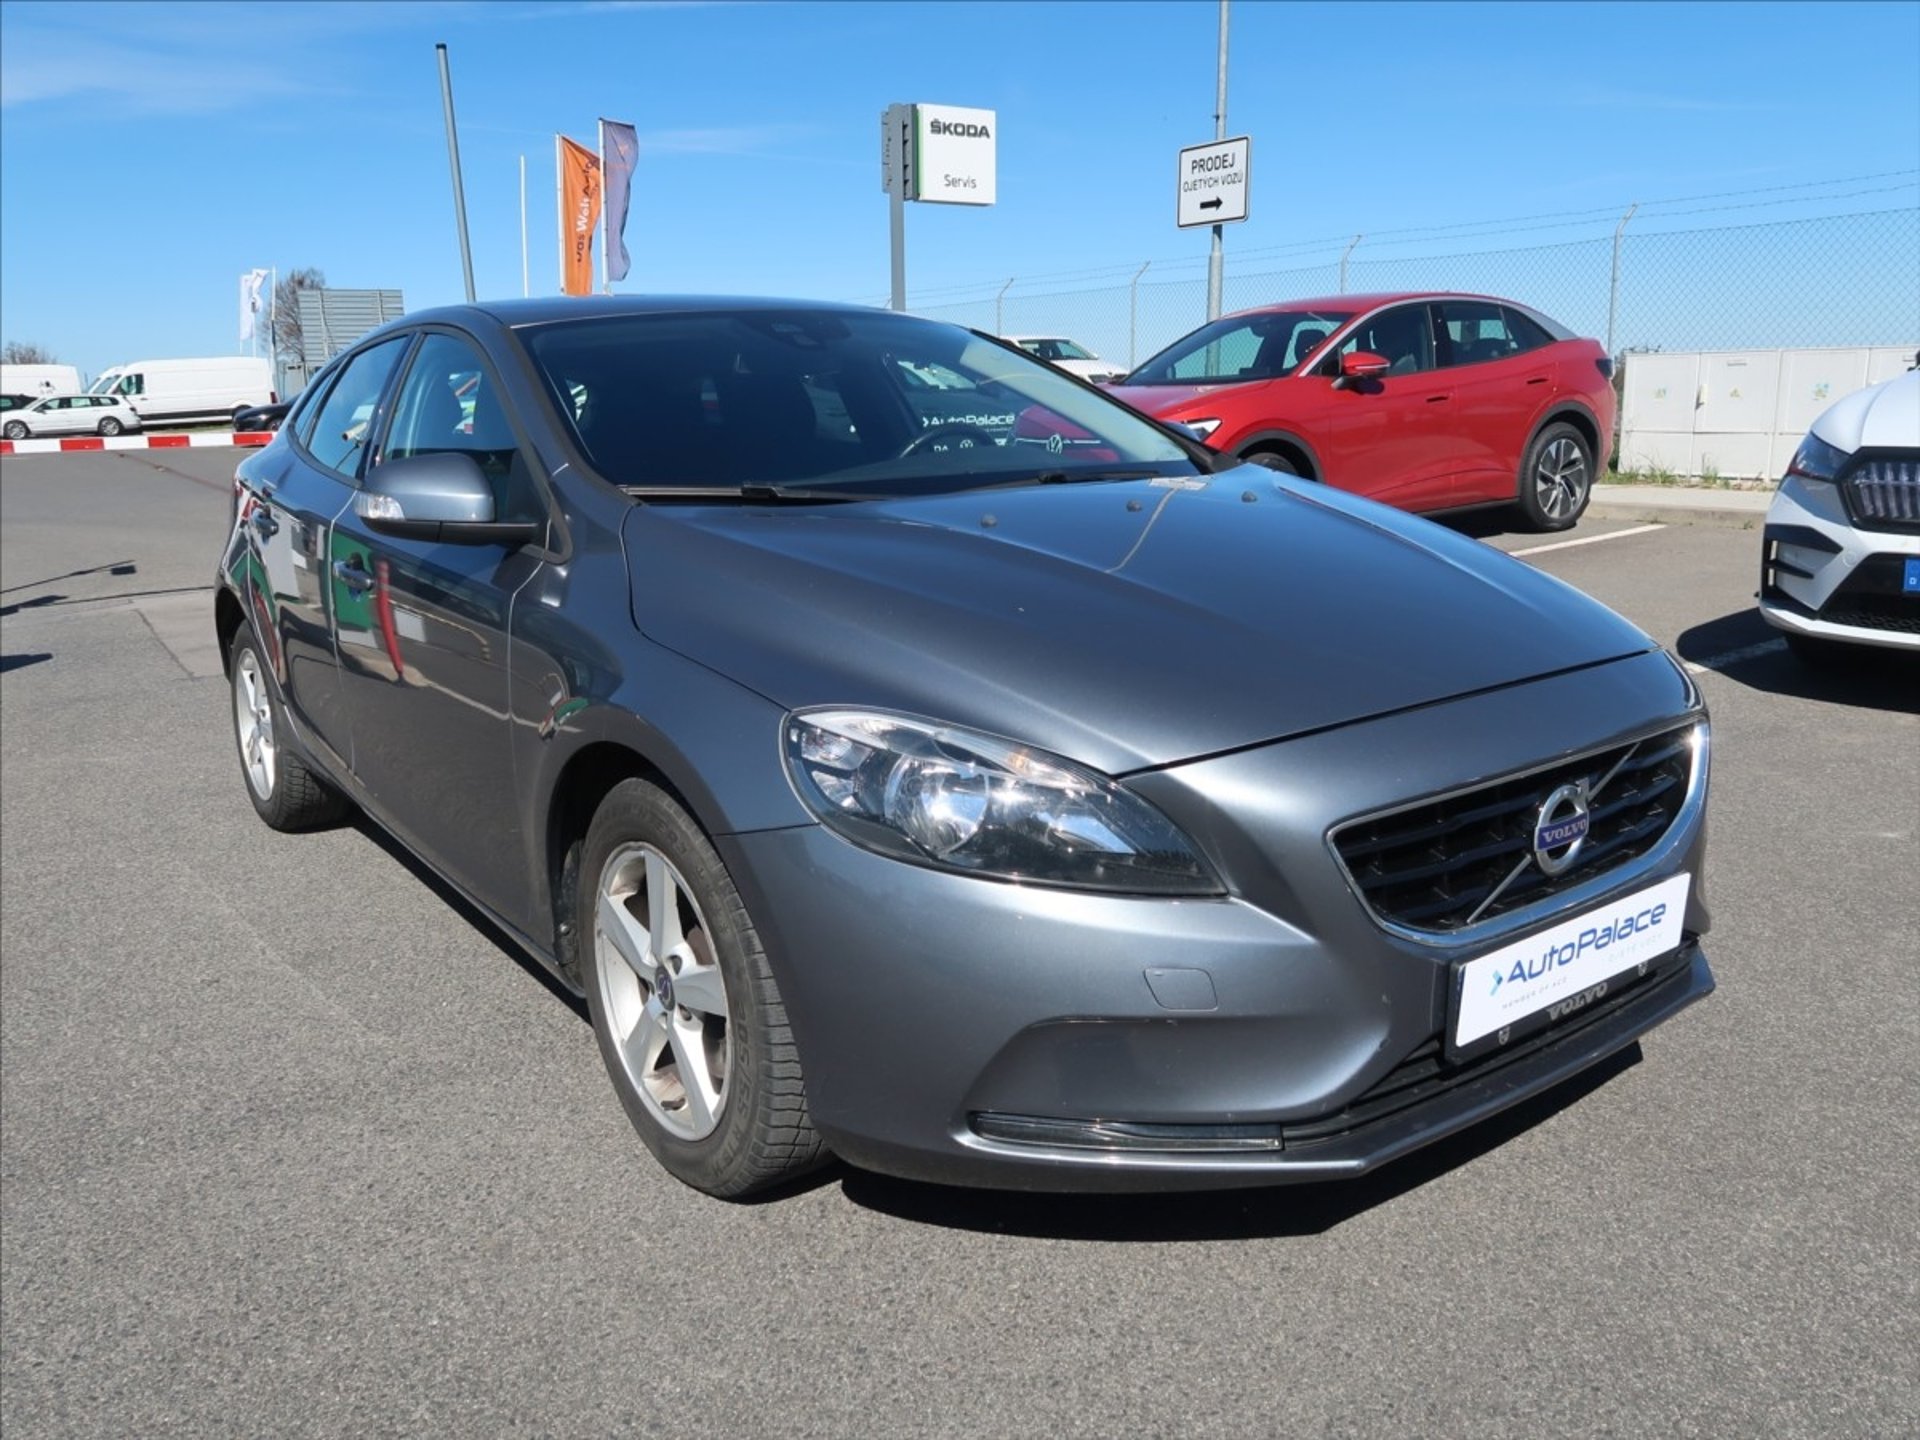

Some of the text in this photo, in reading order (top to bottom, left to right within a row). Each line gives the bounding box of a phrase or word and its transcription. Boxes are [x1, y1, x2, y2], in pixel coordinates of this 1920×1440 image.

[930, 118, 990, 139] ŠKODA
[1192, 152, 1236, 175] PRODEJ
[944, 173, 977, 189] Servis
[1543, 819, 1587, 843] VOLVO
[1506, 902, 1667, 984] AutoPalace
[1546, 982, 1609, 1021] VOLVO
